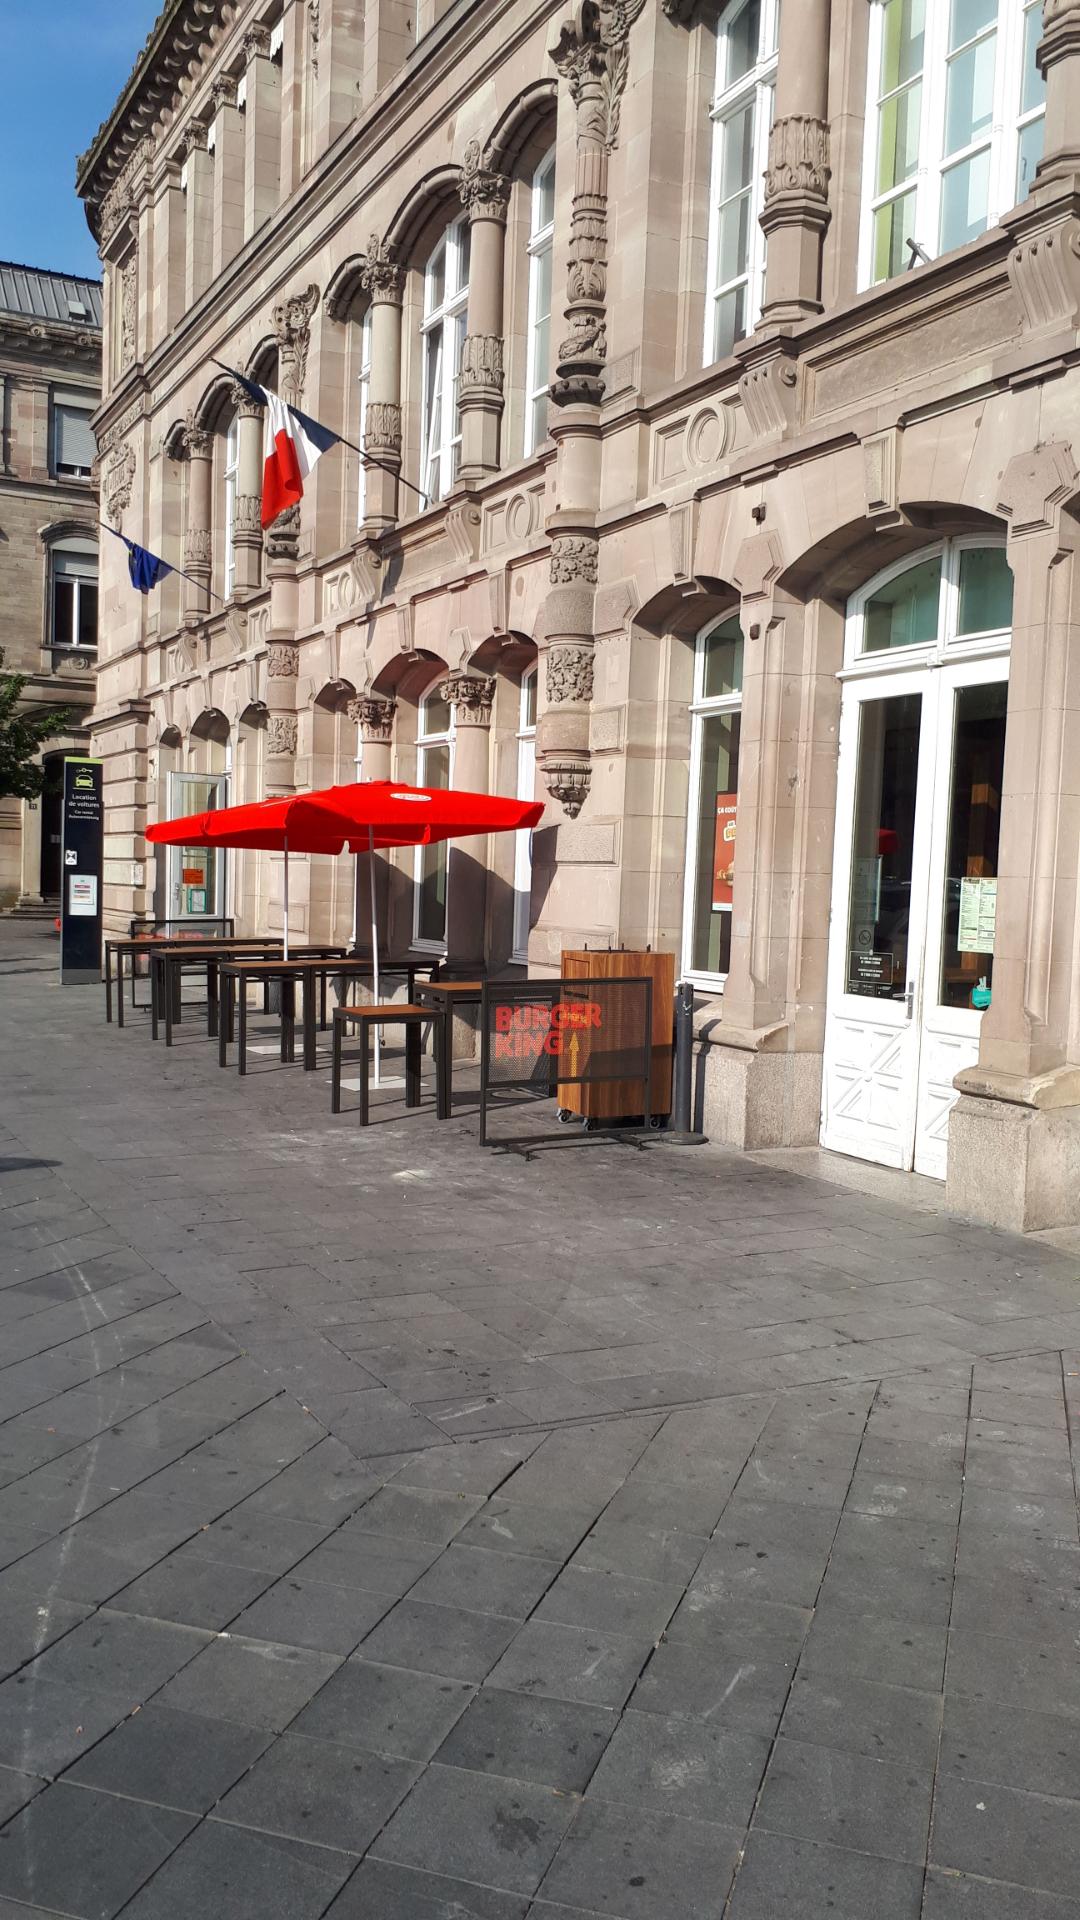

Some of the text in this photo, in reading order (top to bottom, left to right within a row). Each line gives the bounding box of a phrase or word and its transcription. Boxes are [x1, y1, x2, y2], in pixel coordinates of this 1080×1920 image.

[72, 793, 97, 801] Location
[495, 1003, 602, 1031] BURGER
[495, 1031, 564, 1057] KING
